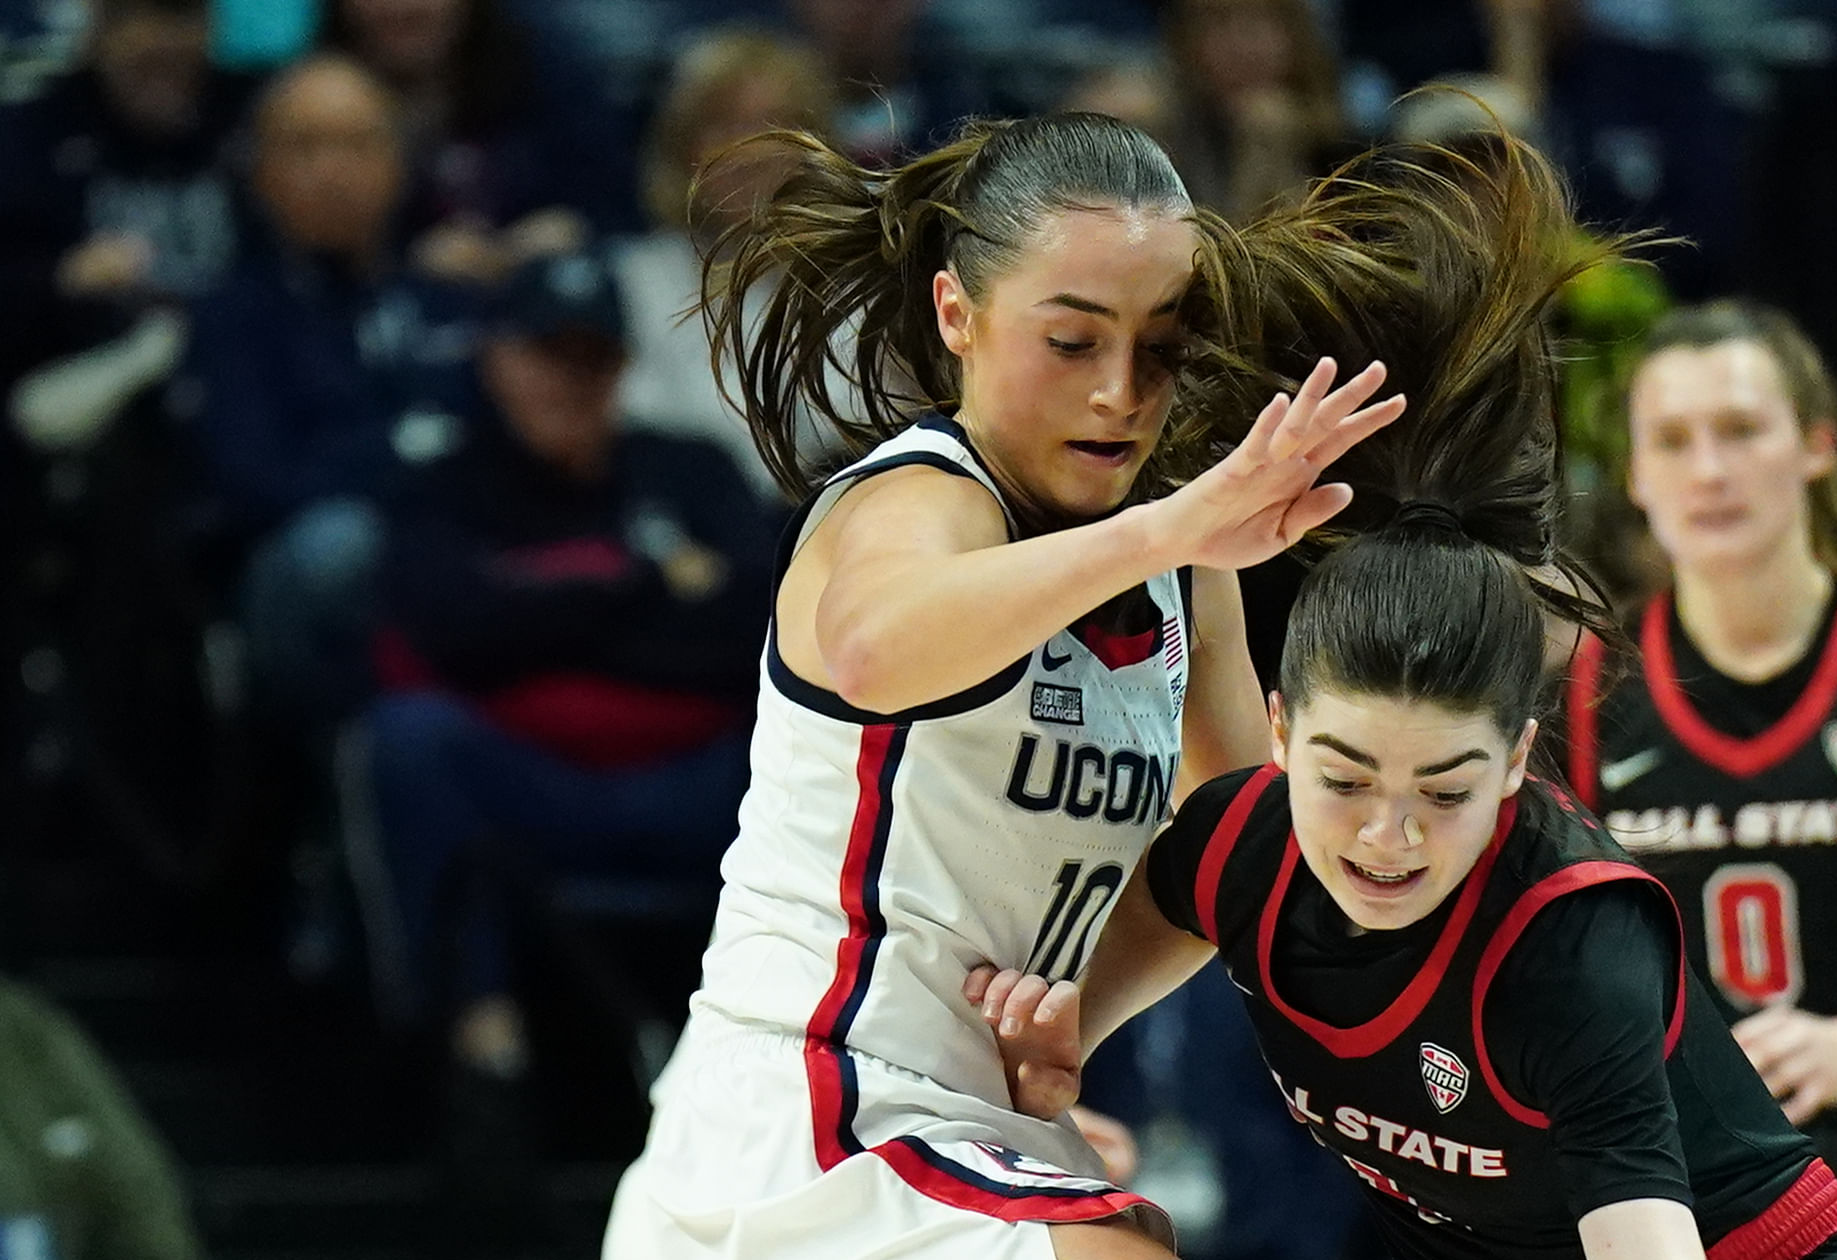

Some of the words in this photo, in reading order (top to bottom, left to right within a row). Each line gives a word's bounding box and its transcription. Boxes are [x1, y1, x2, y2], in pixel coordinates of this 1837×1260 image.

[1032, 704, 1081, 721] CHANGE
[1023, 858, 1124, 982] 10
[1702, 862, 1805, 1007] 0
[1421, 1060, 1466, 1092] MAC
[1333, 1105, 1509, 1178] STATE
